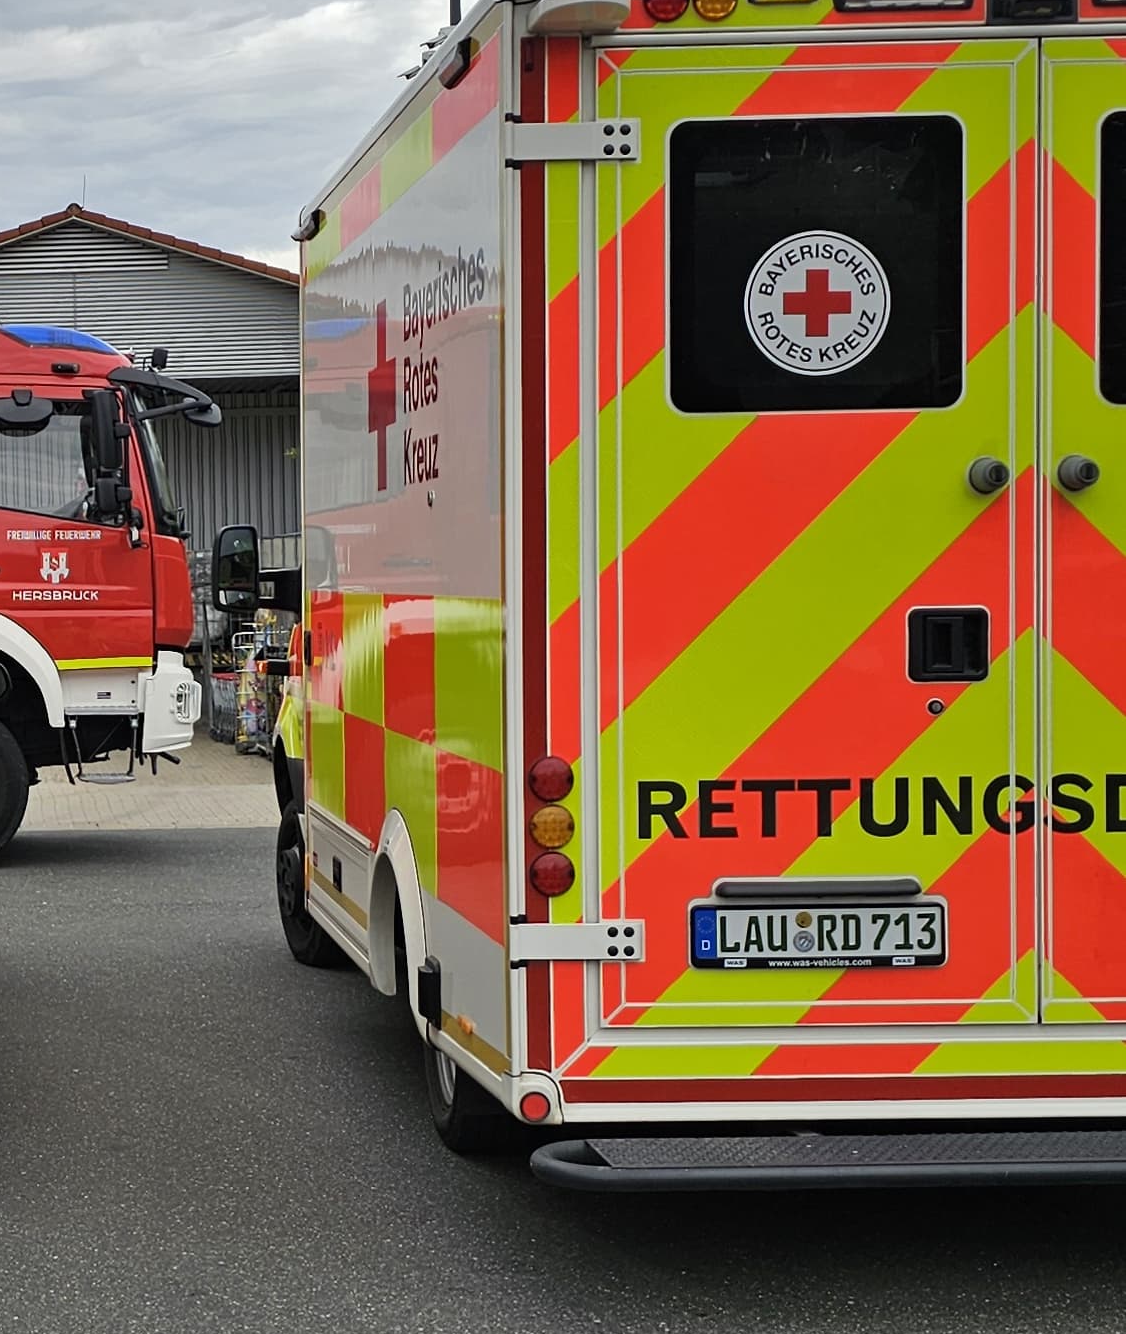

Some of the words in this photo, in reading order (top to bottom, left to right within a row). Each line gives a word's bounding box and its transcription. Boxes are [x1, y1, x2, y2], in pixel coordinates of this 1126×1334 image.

[758, 243, 876, 297] BAYERISCHES
[402, 245, 486, 349] Bayerisches
[757, 311, 813, 363] ROTES
[818, 309, 877, 363] KREUZ
[402, 352, 439, 415] Rotes
[402, 427, 440, 487] Kreuz
[6, 529, 52, 541] FREIWILLIGE
[54, 529, 102, 541] FEUERWEHR
[12, 589, 99, 601] HERSBRUCK
[700, 939, 712, 951] D
[719, 914, 788, 954] LAU
[816, 913, 862, 952] RD
[870, 912, 937, 951] 713
[767, 957, 872, 968] www.was-vehicles.com
